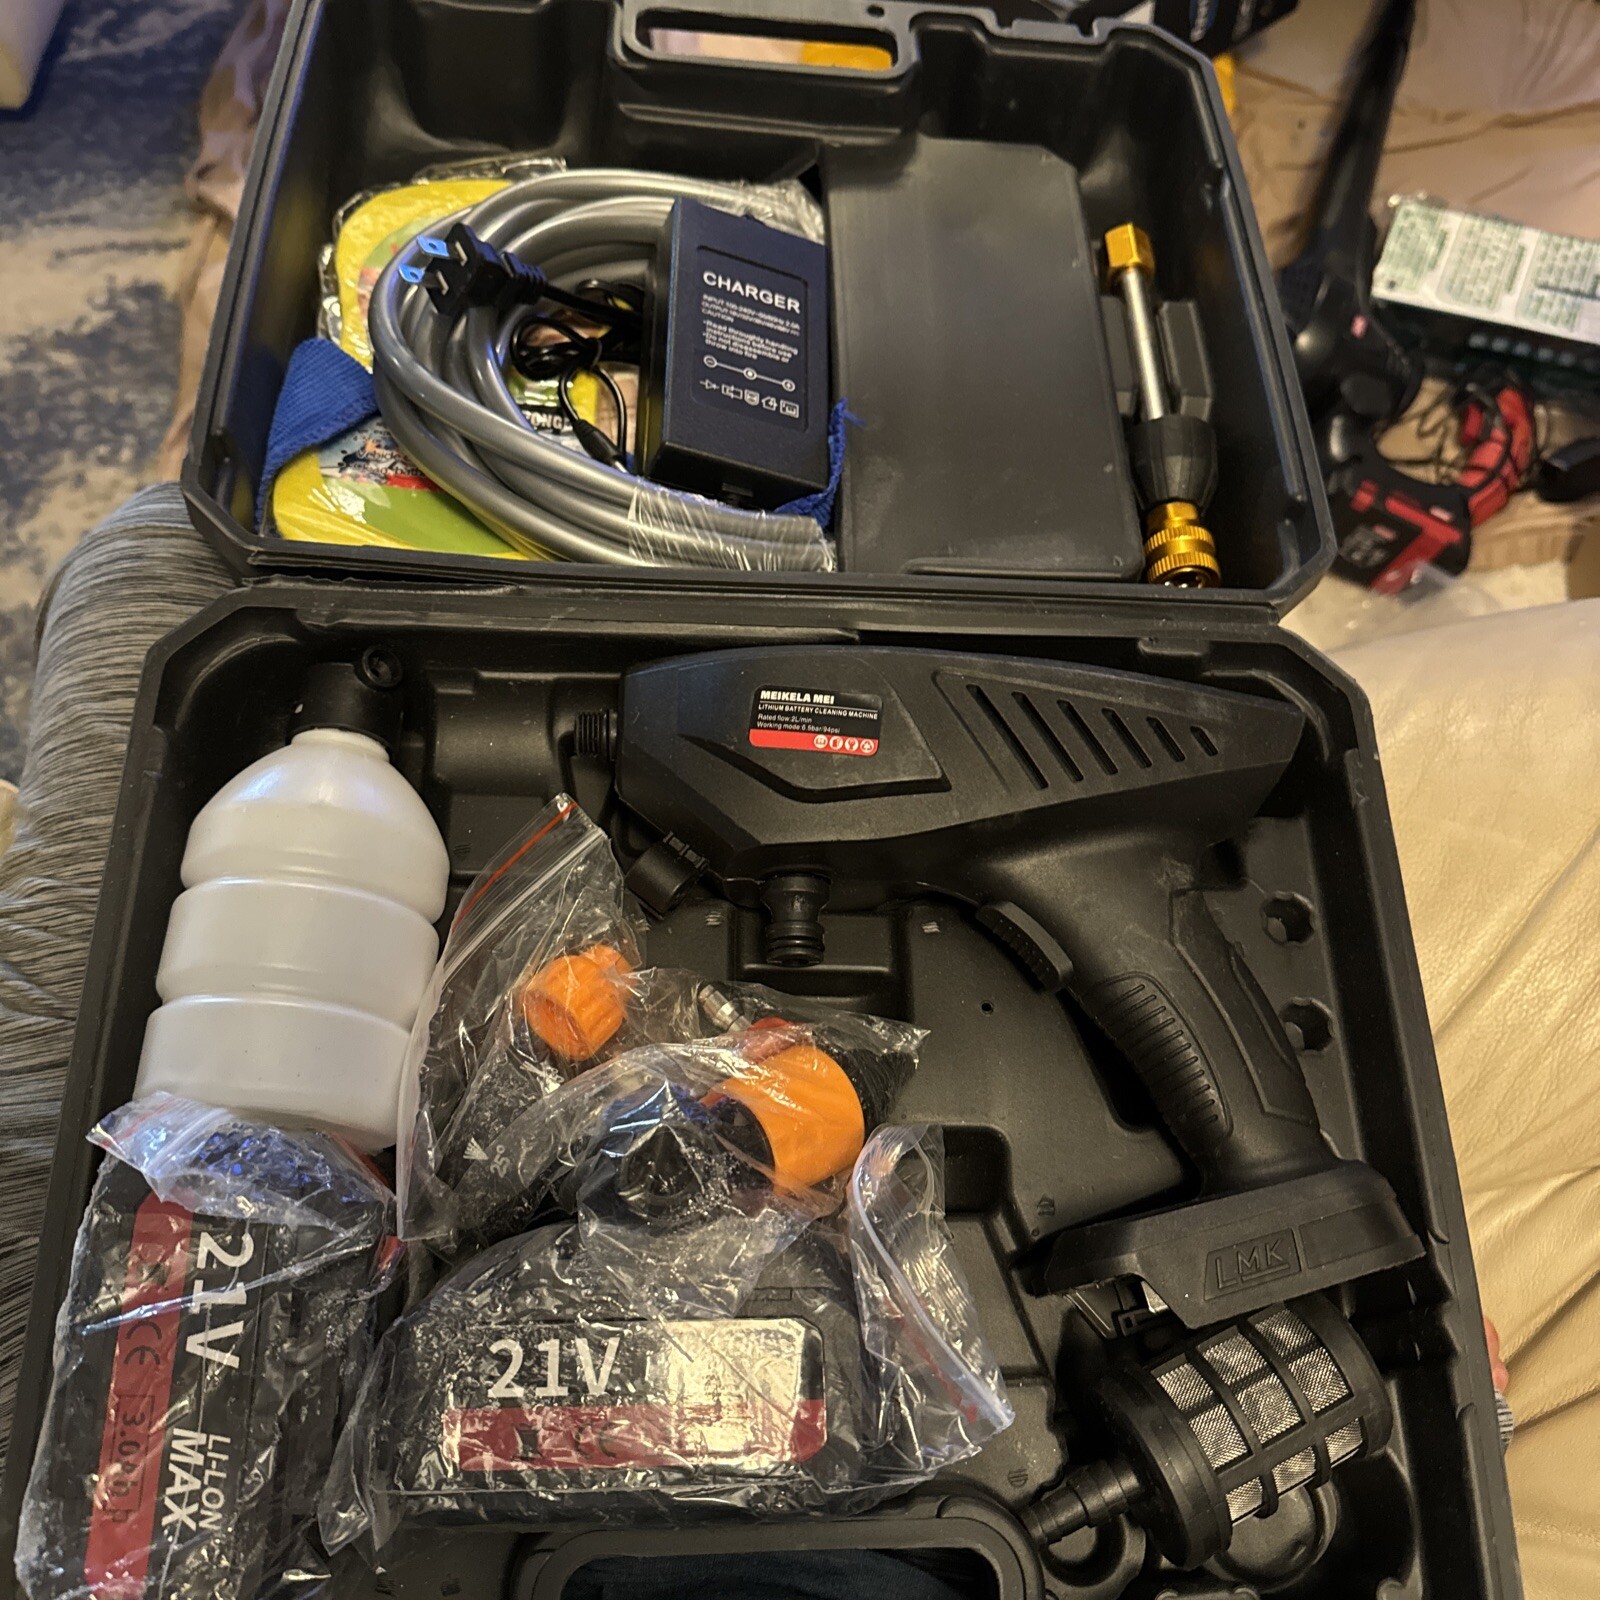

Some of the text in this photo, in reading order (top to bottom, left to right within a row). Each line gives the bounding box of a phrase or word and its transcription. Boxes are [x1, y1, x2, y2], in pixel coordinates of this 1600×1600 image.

[703, 271, 800, 314] CHARGER
[701, 308, 734, 323] CAUTION
[757, 713, 777, 721] Rated
[760, 690, 835, 705] MEIKELA MEI
[784, 705, 814, 713] BATTERY
[814, 707, 847, 717] CLEANING
[848, 711, 878, 720] MACHINE
[756, 721, 782, 730] Working
[1214, 1239, 1283, 1289] LMK
[185, 1231, 255, 1369] 21V
[487, 1337, 621, 1398] 21V
[161, 1427, 207, 1532] MAX
[199, 1433, 231, 1530] LI-LON
